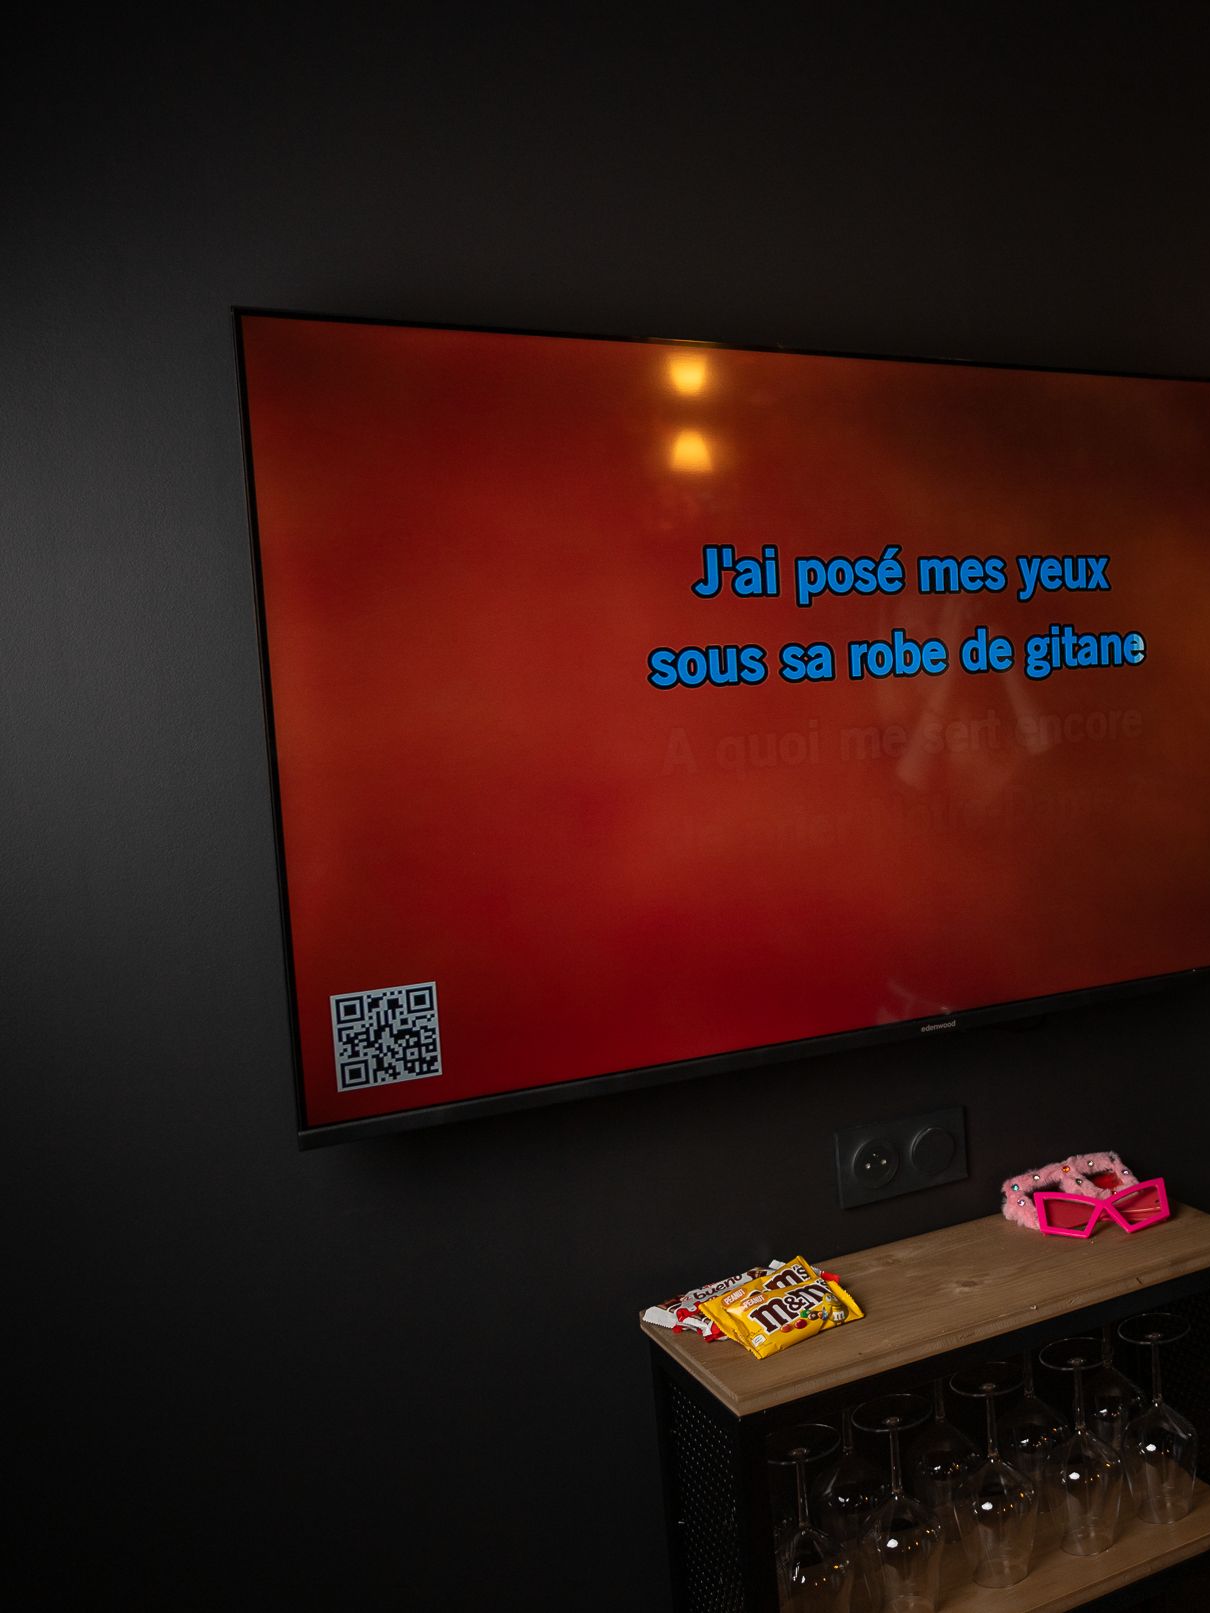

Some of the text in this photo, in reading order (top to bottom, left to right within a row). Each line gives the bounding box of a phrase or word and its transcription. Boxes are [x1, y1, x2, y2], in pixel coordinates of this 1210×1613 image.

[694, 546, 1110, 606] J'ai posé mes yeux
[649, 624, 1145, 688] sous sa robe de gitane
[662, 707, 1144, 781] A quoi me sert encore
[921, 1020, 956, 1032] edenwood
[693, 1274, 742, 1300] bueno
[723, 1288, 746, 1305] PEANUT
